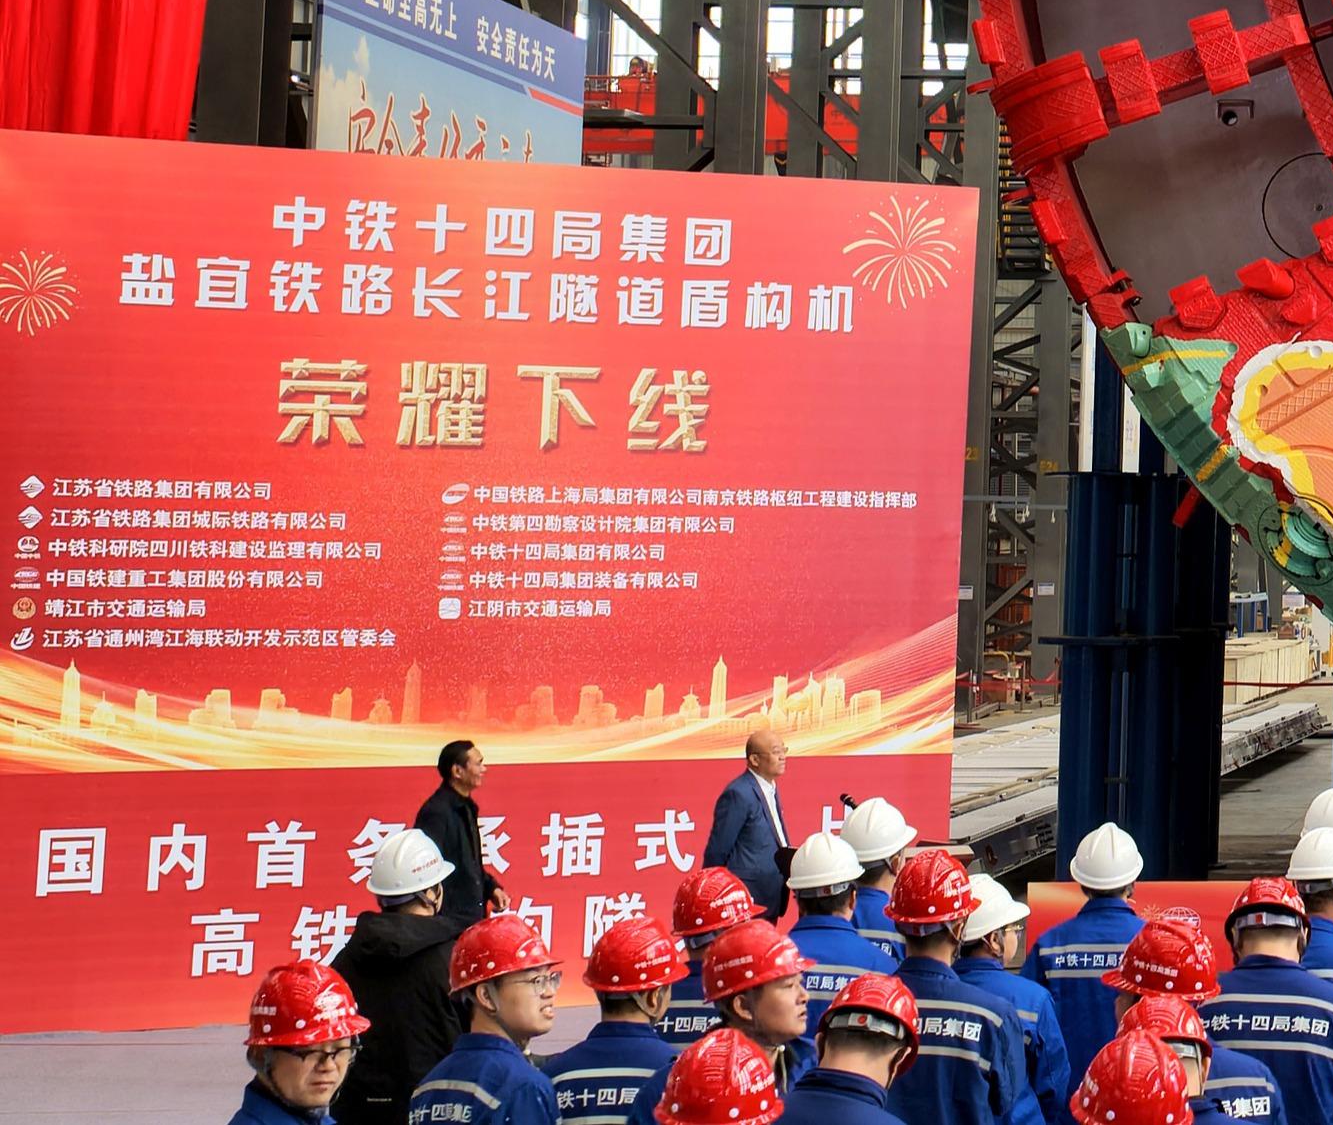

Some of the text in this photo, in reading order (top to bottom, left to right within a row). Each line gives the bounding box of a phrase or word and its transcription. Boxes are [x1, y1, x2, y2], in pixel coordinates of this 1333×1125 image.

[476, 16, 556, 82] 安全责任为天
[273, 196, 733, 267] 中铁十四局集团
[119, 252, 855, 334] 盐宜铁路长江隧道盾构机
[277, 358, 712, 453] 荣耀下线
[52, 478, 272, 500] 江苏省铁路集团有限公司
[473, 485, 918, 509] 中国铁路上海局集团有限公司南京铁路枢纽工程建设指挥部
[50, 508, 347, 531] 江苏省铁路集团城际铁路有限公司
[472, 514, 735, 535] 中铁第四勘察设计院集团有限公司
[47, 538, 382, 560] 中铁科研院四川铁科建设监理有限公司
[470, 543, 666, 562] 中铁十四局集团有限公司
[46, 568, 324, 590] 中国铁建重工集团股份有限公司
[468, 571, 699, 591] 中铁十四局集团装备有限公司
[44, 598, 207, 619] 靖江市交通运输局
[468, 599, 612, 619] 江阴市交通运输局
[42, 628, 397, 649] 江苏省通州湾江海联动开发示范区管委会
[806, 975, 859, 991] 四局集
